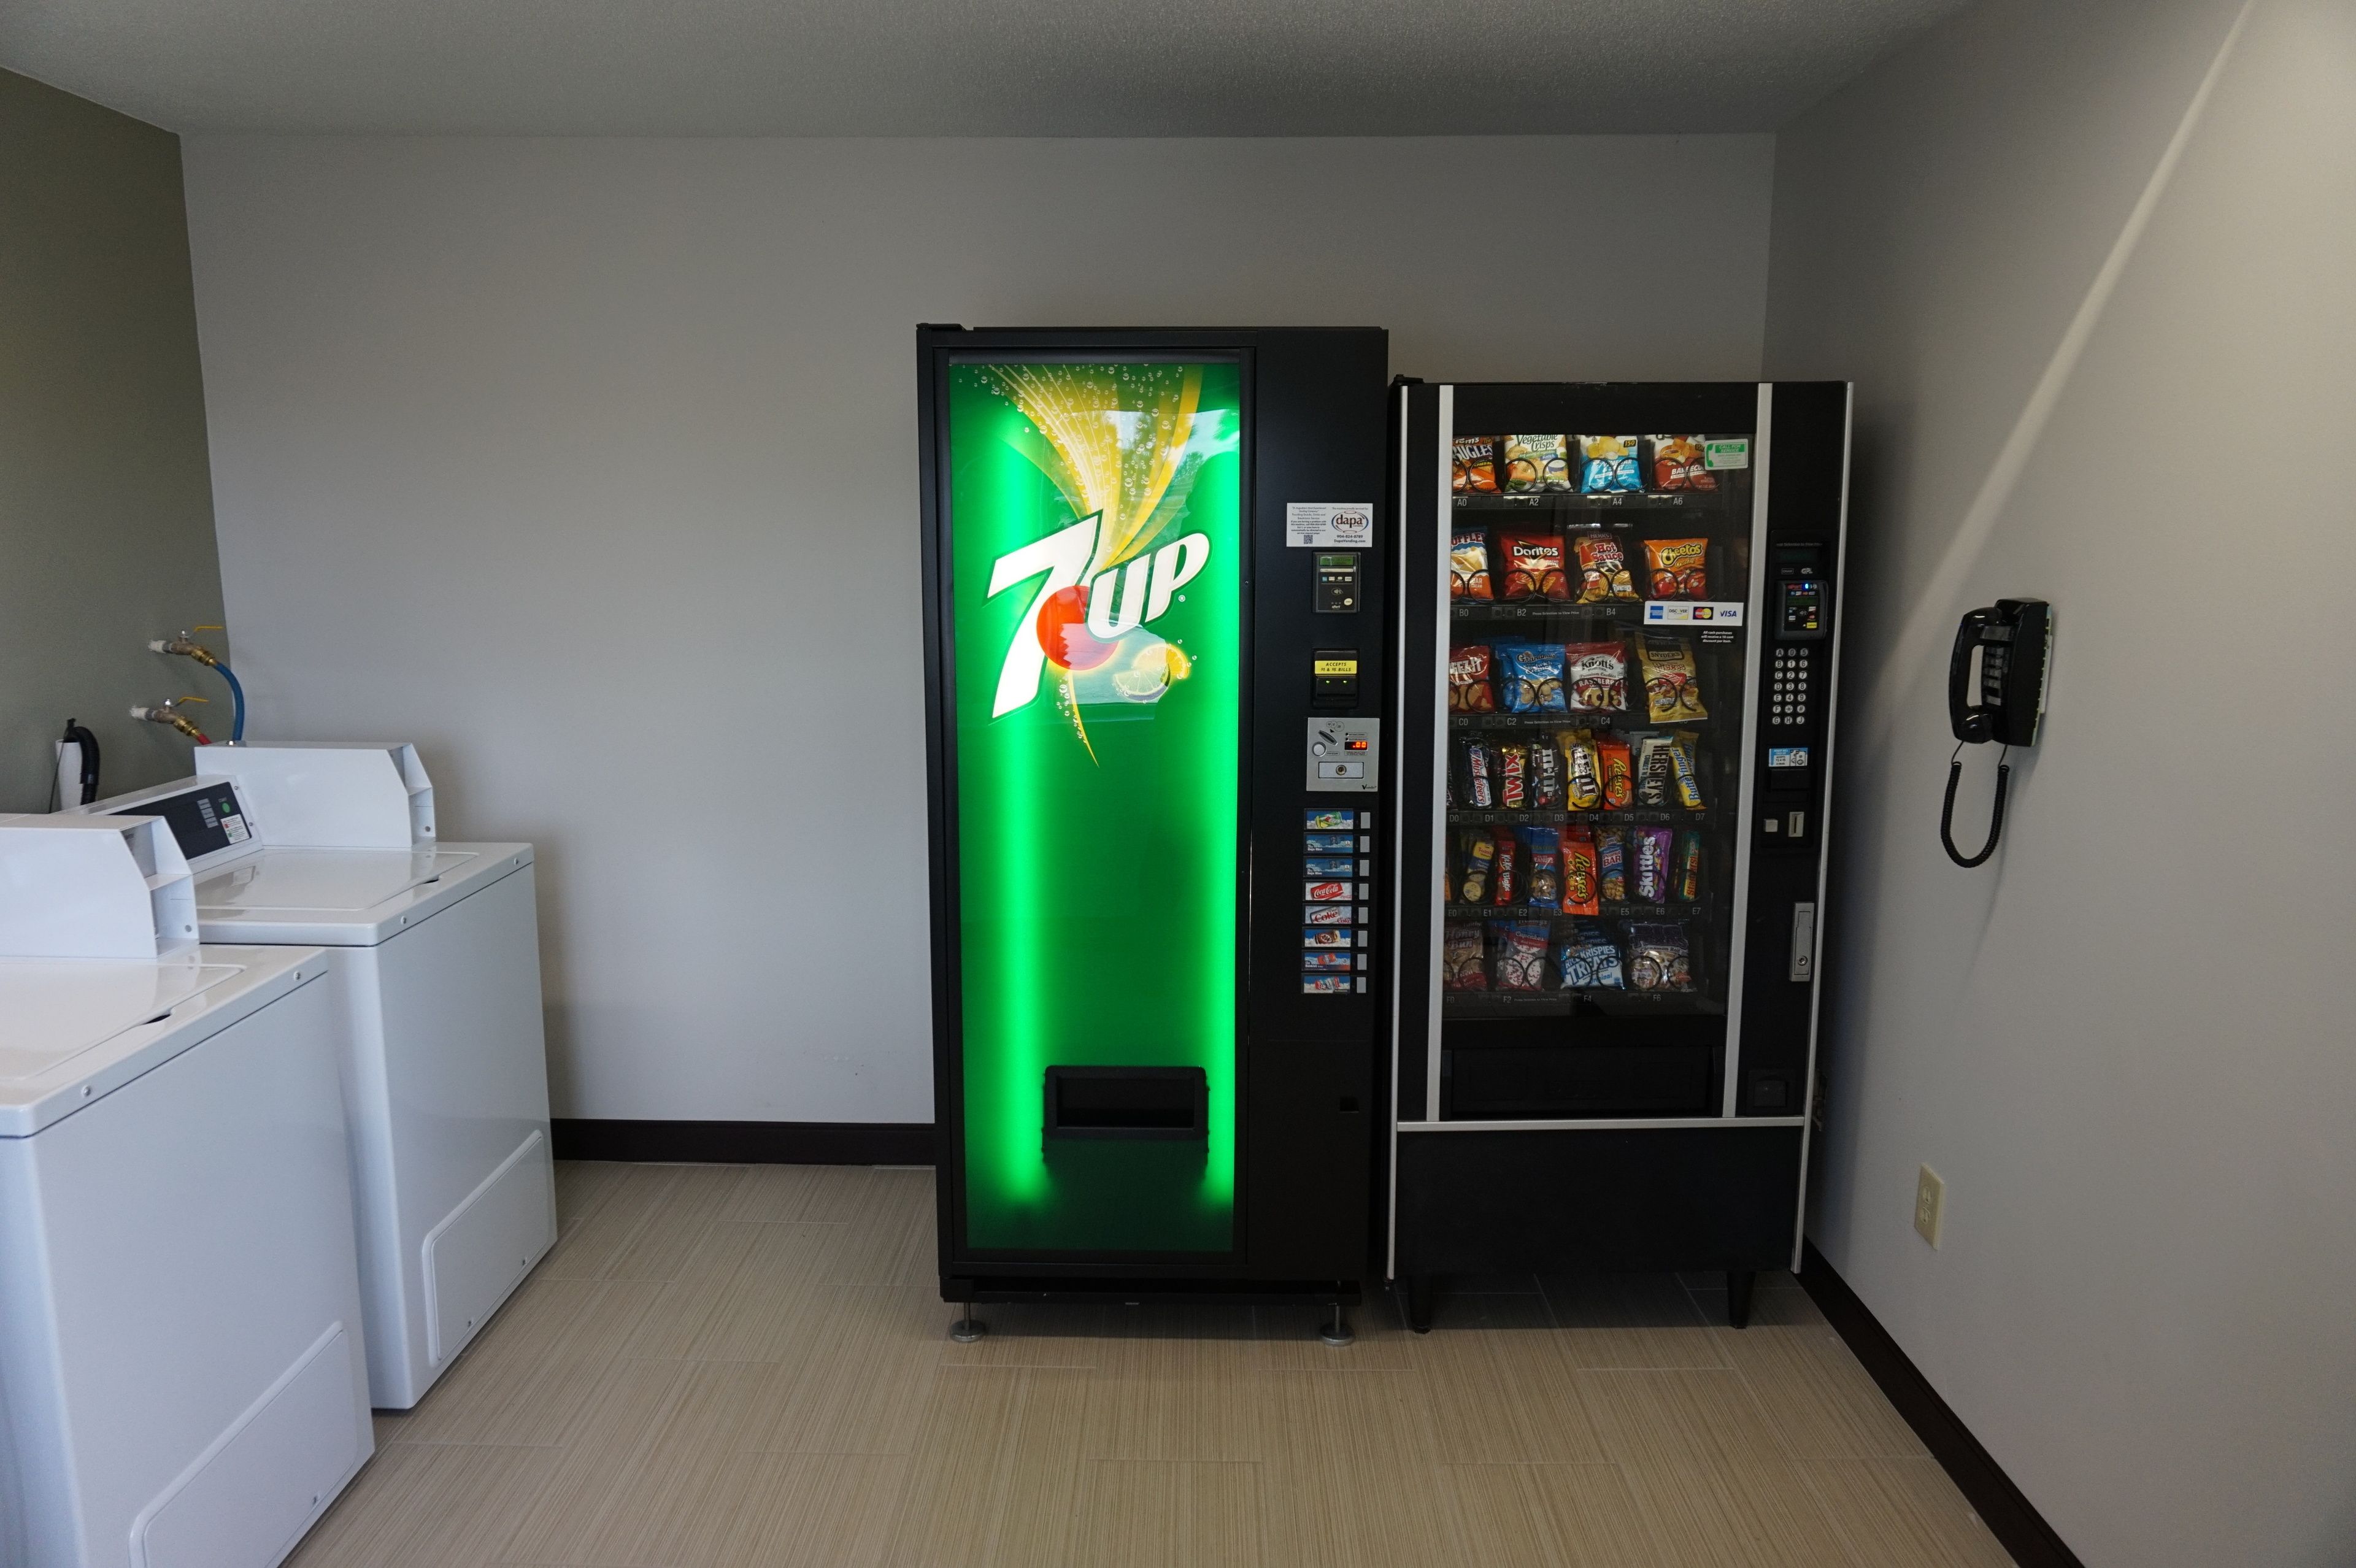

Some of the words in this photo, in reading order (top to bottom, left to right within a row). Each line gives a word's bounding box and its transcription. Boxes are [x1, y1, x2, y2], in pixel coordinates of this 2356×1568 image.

[1533, 438, 1555, 452] Crisps
[1336, 514, 1362, 528] dapa
[1513, 546, 1558, 556] Doritos
[1595, 542, 1617, 553] Hot
[1592, 551, 1623, 563] Sauce
[1661, 544, 1702, 566] Cheetos
[1581, 659, 1614, 671] Knott's
[1504, 754, 1523, 807] TWIX
[1612, 758, 1627, 799] Reese's
[1671, 748, 1701, 801] Buttefinger
[1603, 856, 1622, 867] BAR
[1639, 836, 1656, 897] Skittles
[1574, 851, 1591, 899] Reese's
[1313, 911, 1339, 923] Coke
[1580, 945, 1615, 959] KRISPIES
[1567, 955, 1618, 985] TREATS
